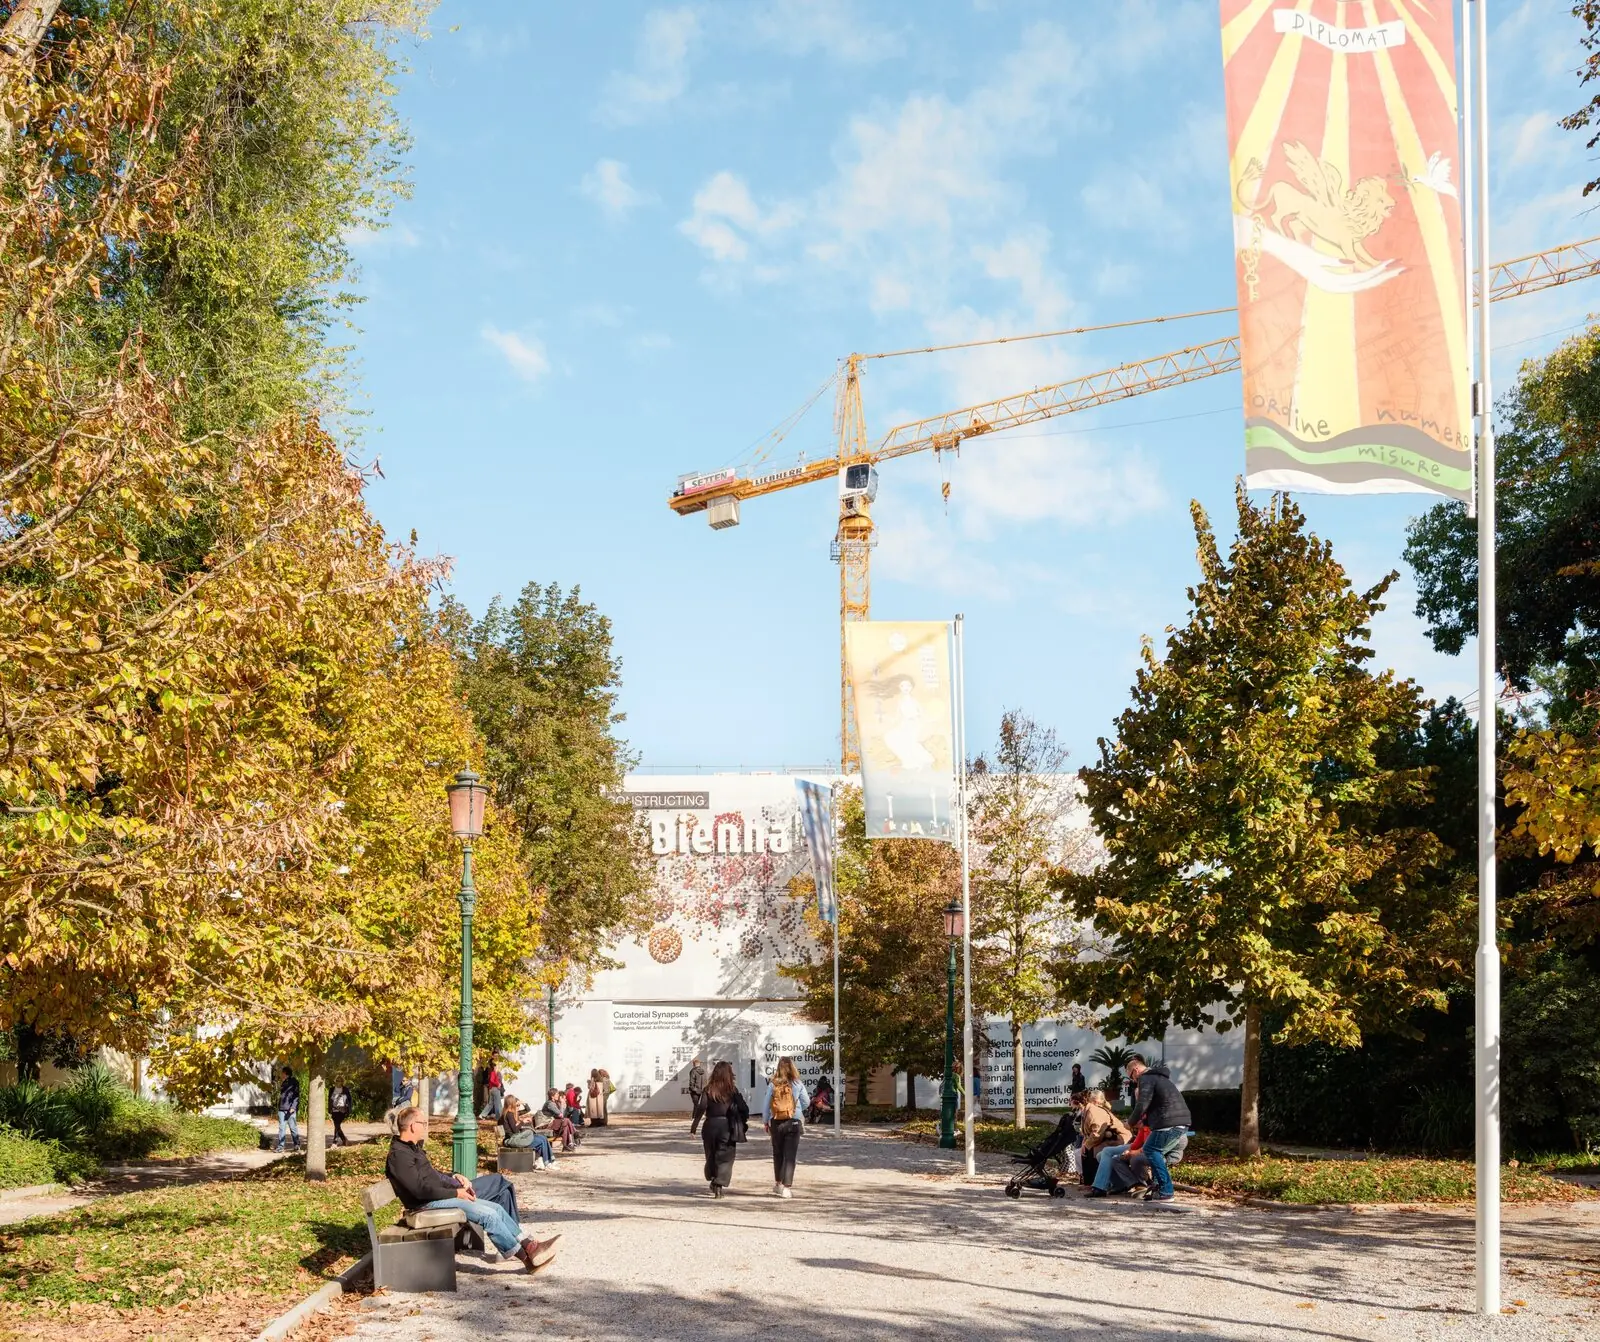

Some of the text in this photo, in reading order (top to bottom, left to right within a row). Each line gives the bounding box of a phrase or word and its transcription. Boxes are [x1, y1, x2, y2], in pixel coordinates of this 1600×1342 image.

[1292, 13, 1388, 47] DIPLOMAT
[652, 1011, 689, 1019] Synapses
[765, 1043, 780, 1052] Chi
[782, 1044, 804, 1052] sono
[1025, 1039, 1058, 1049] quinte?
[1027, 1050, 1041, 1058] the
[1043, 1049, 1080, 1058] scenes?
[809, 1066, 820, 1074] dà
[1024, 1086, 1063, 1095] trumenti,
